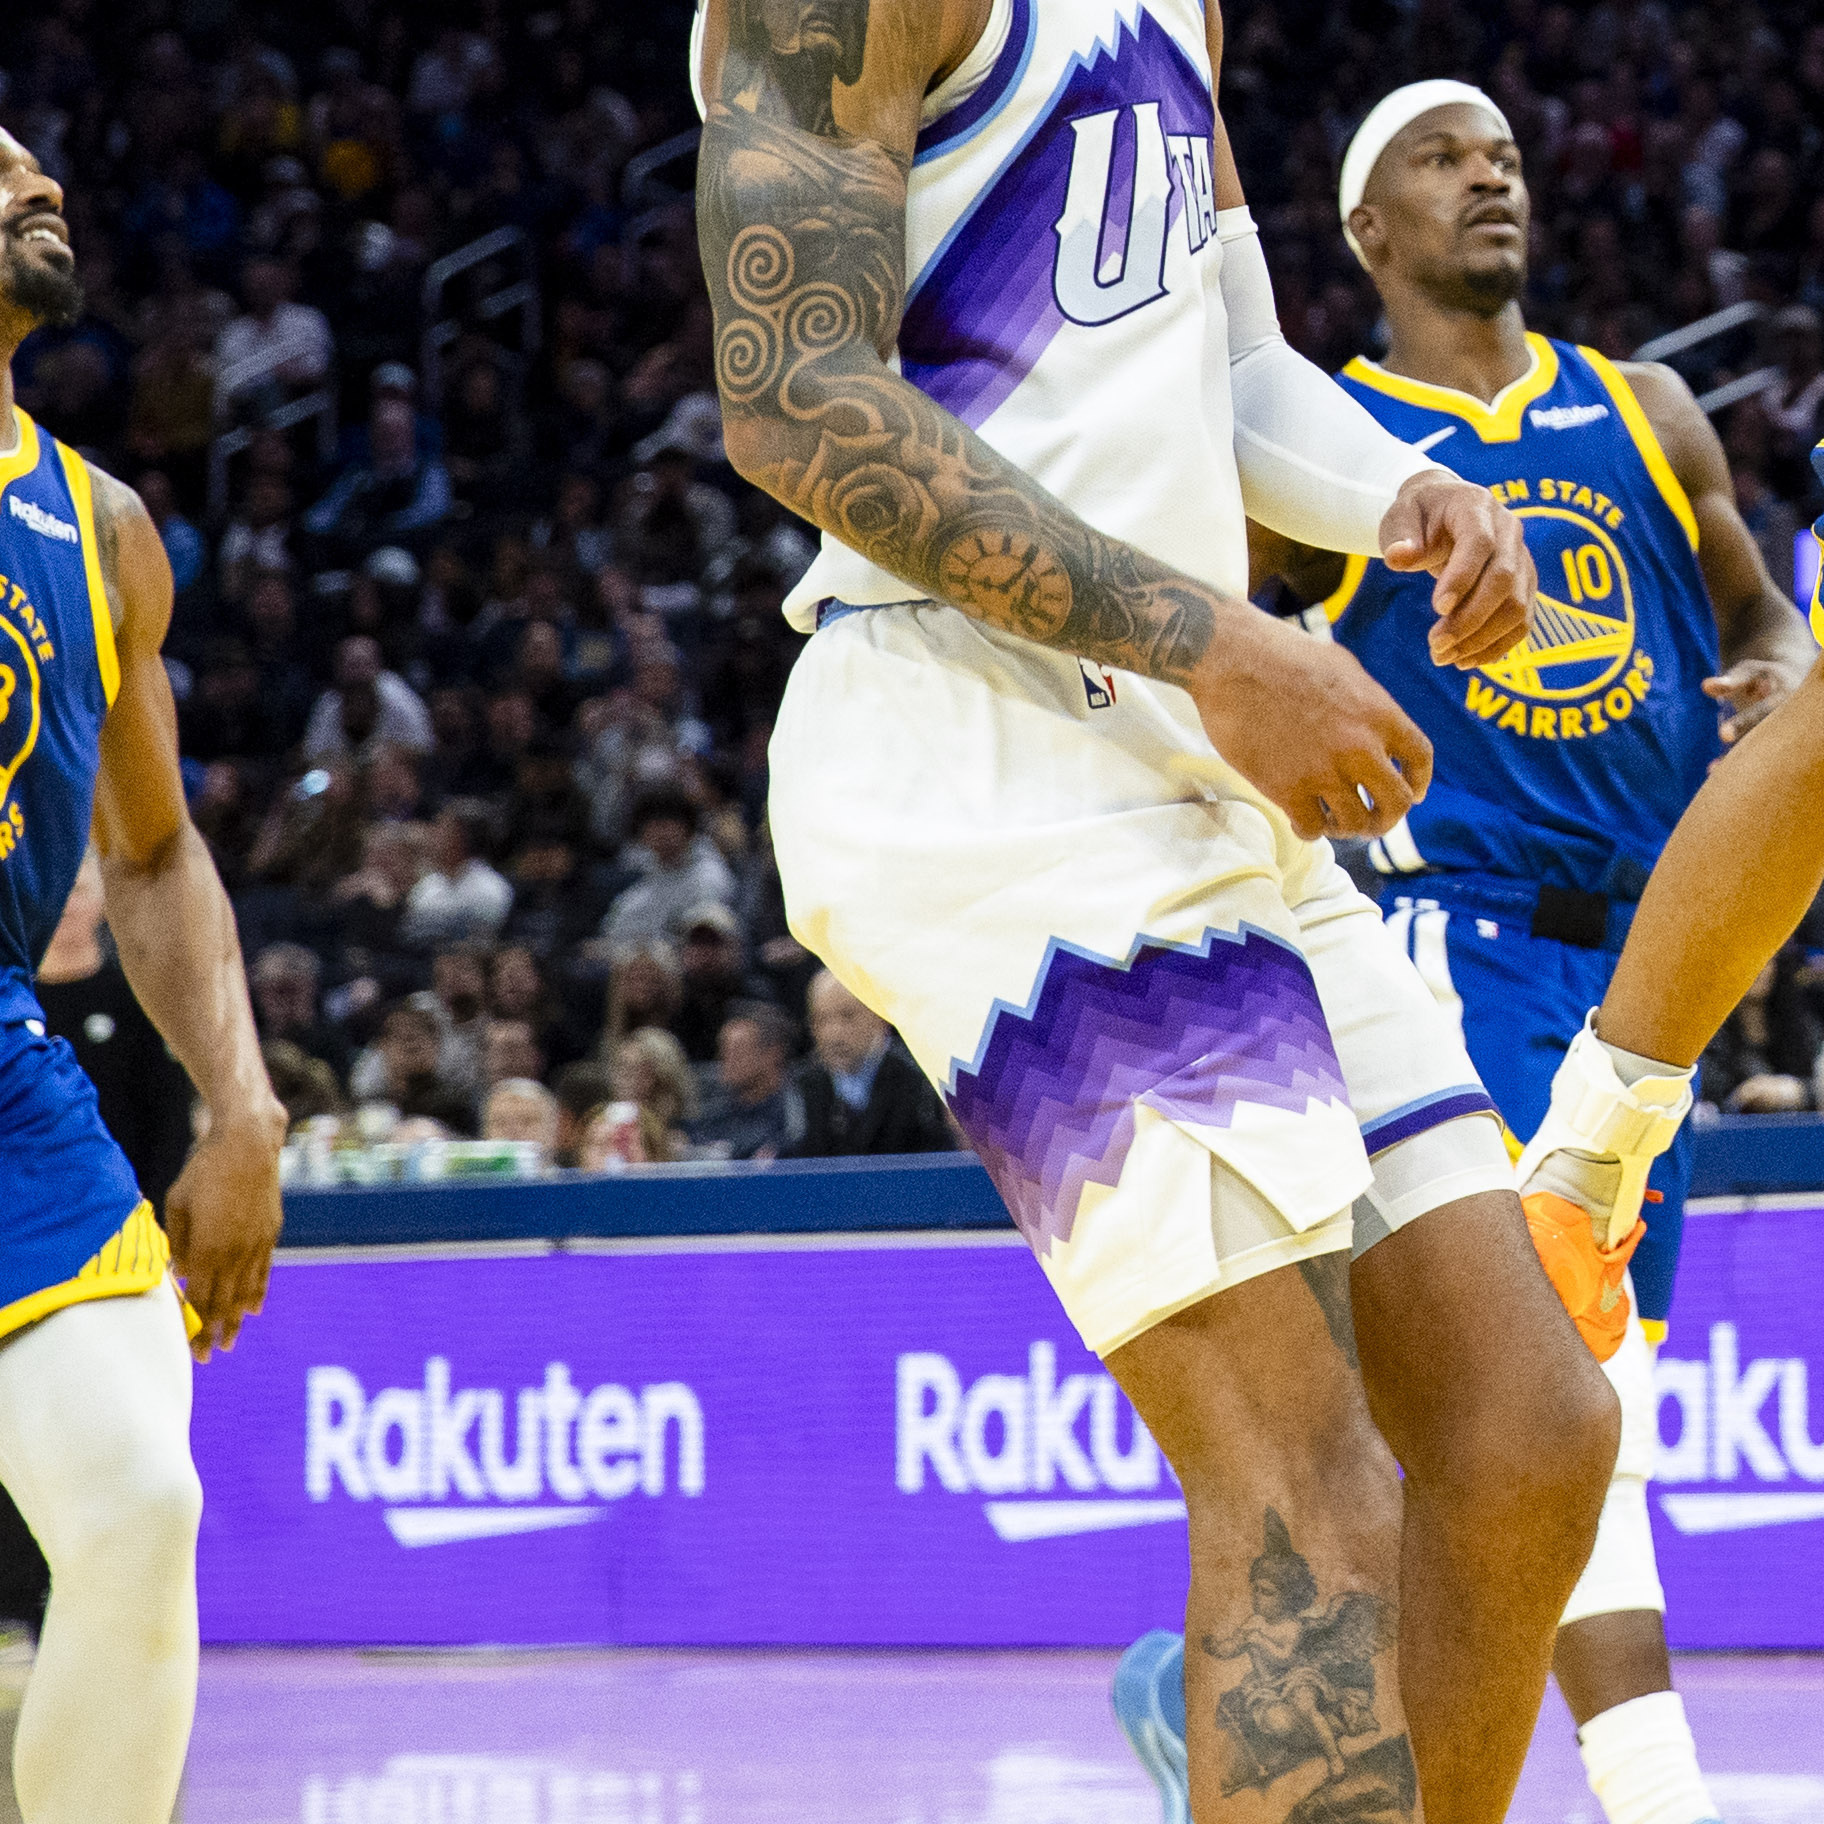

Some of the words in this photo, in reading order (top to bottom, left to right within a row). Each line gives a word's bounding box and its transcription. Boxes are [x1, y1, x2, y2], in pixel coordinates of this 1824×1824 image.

[1052, 100, 1217, 327] UTA
[1529, 403, 1609, 430] Rakuten
[9, 494, 78, 544] Rakuten
[1539, 478, 1625, 530] STATE
[1560, 543, 1613, 604] 10
[1464, 649, 1655, 740] WARRIORS
[304, 1356, 706, 1504] Rakuten
[894, 1340, 1165, 1495] Raku
